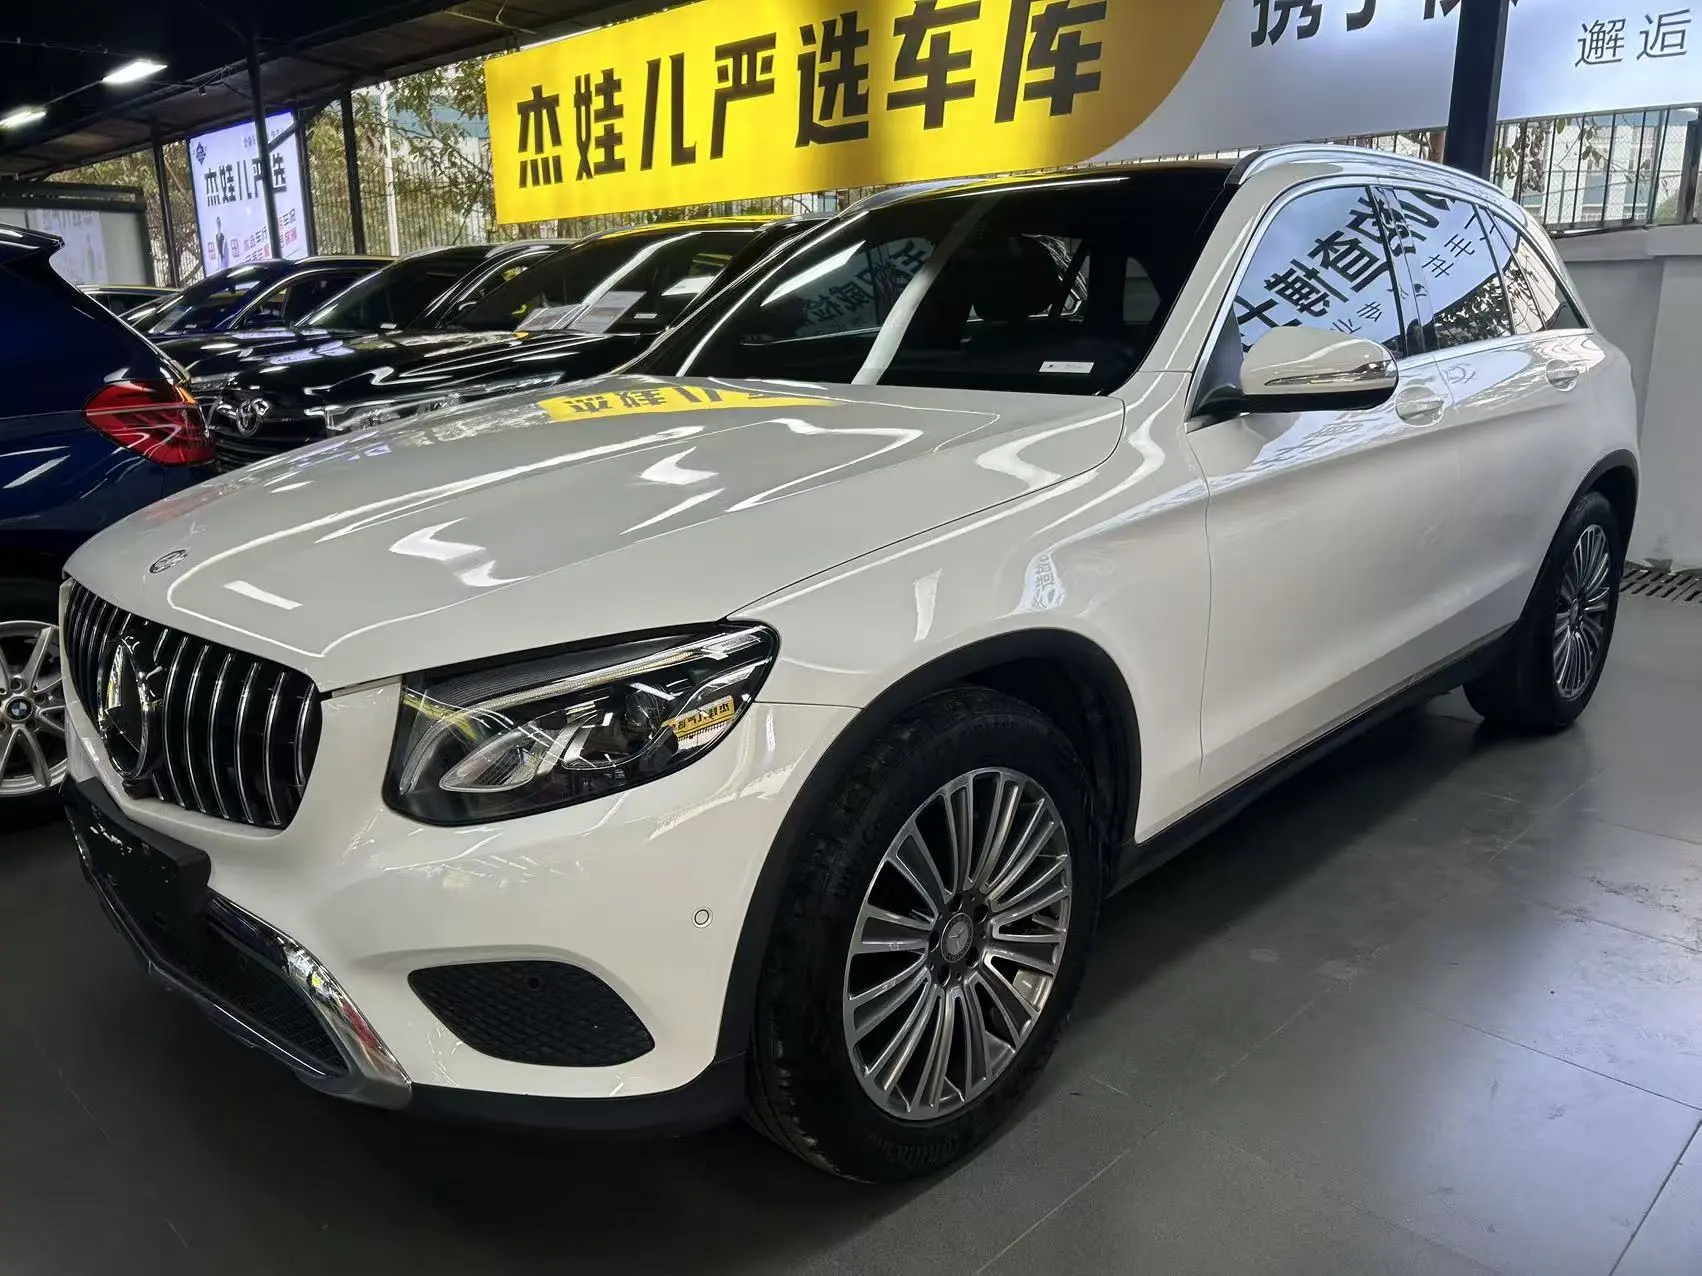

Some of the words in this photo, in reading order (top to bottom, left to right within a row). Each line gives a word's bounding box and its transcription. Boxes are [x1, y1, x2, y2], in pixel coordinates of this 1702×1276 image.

[518, 0, 1105, 189] 杰娃儿严选车库
[1574, 8, 1692, 67] 邂逅
